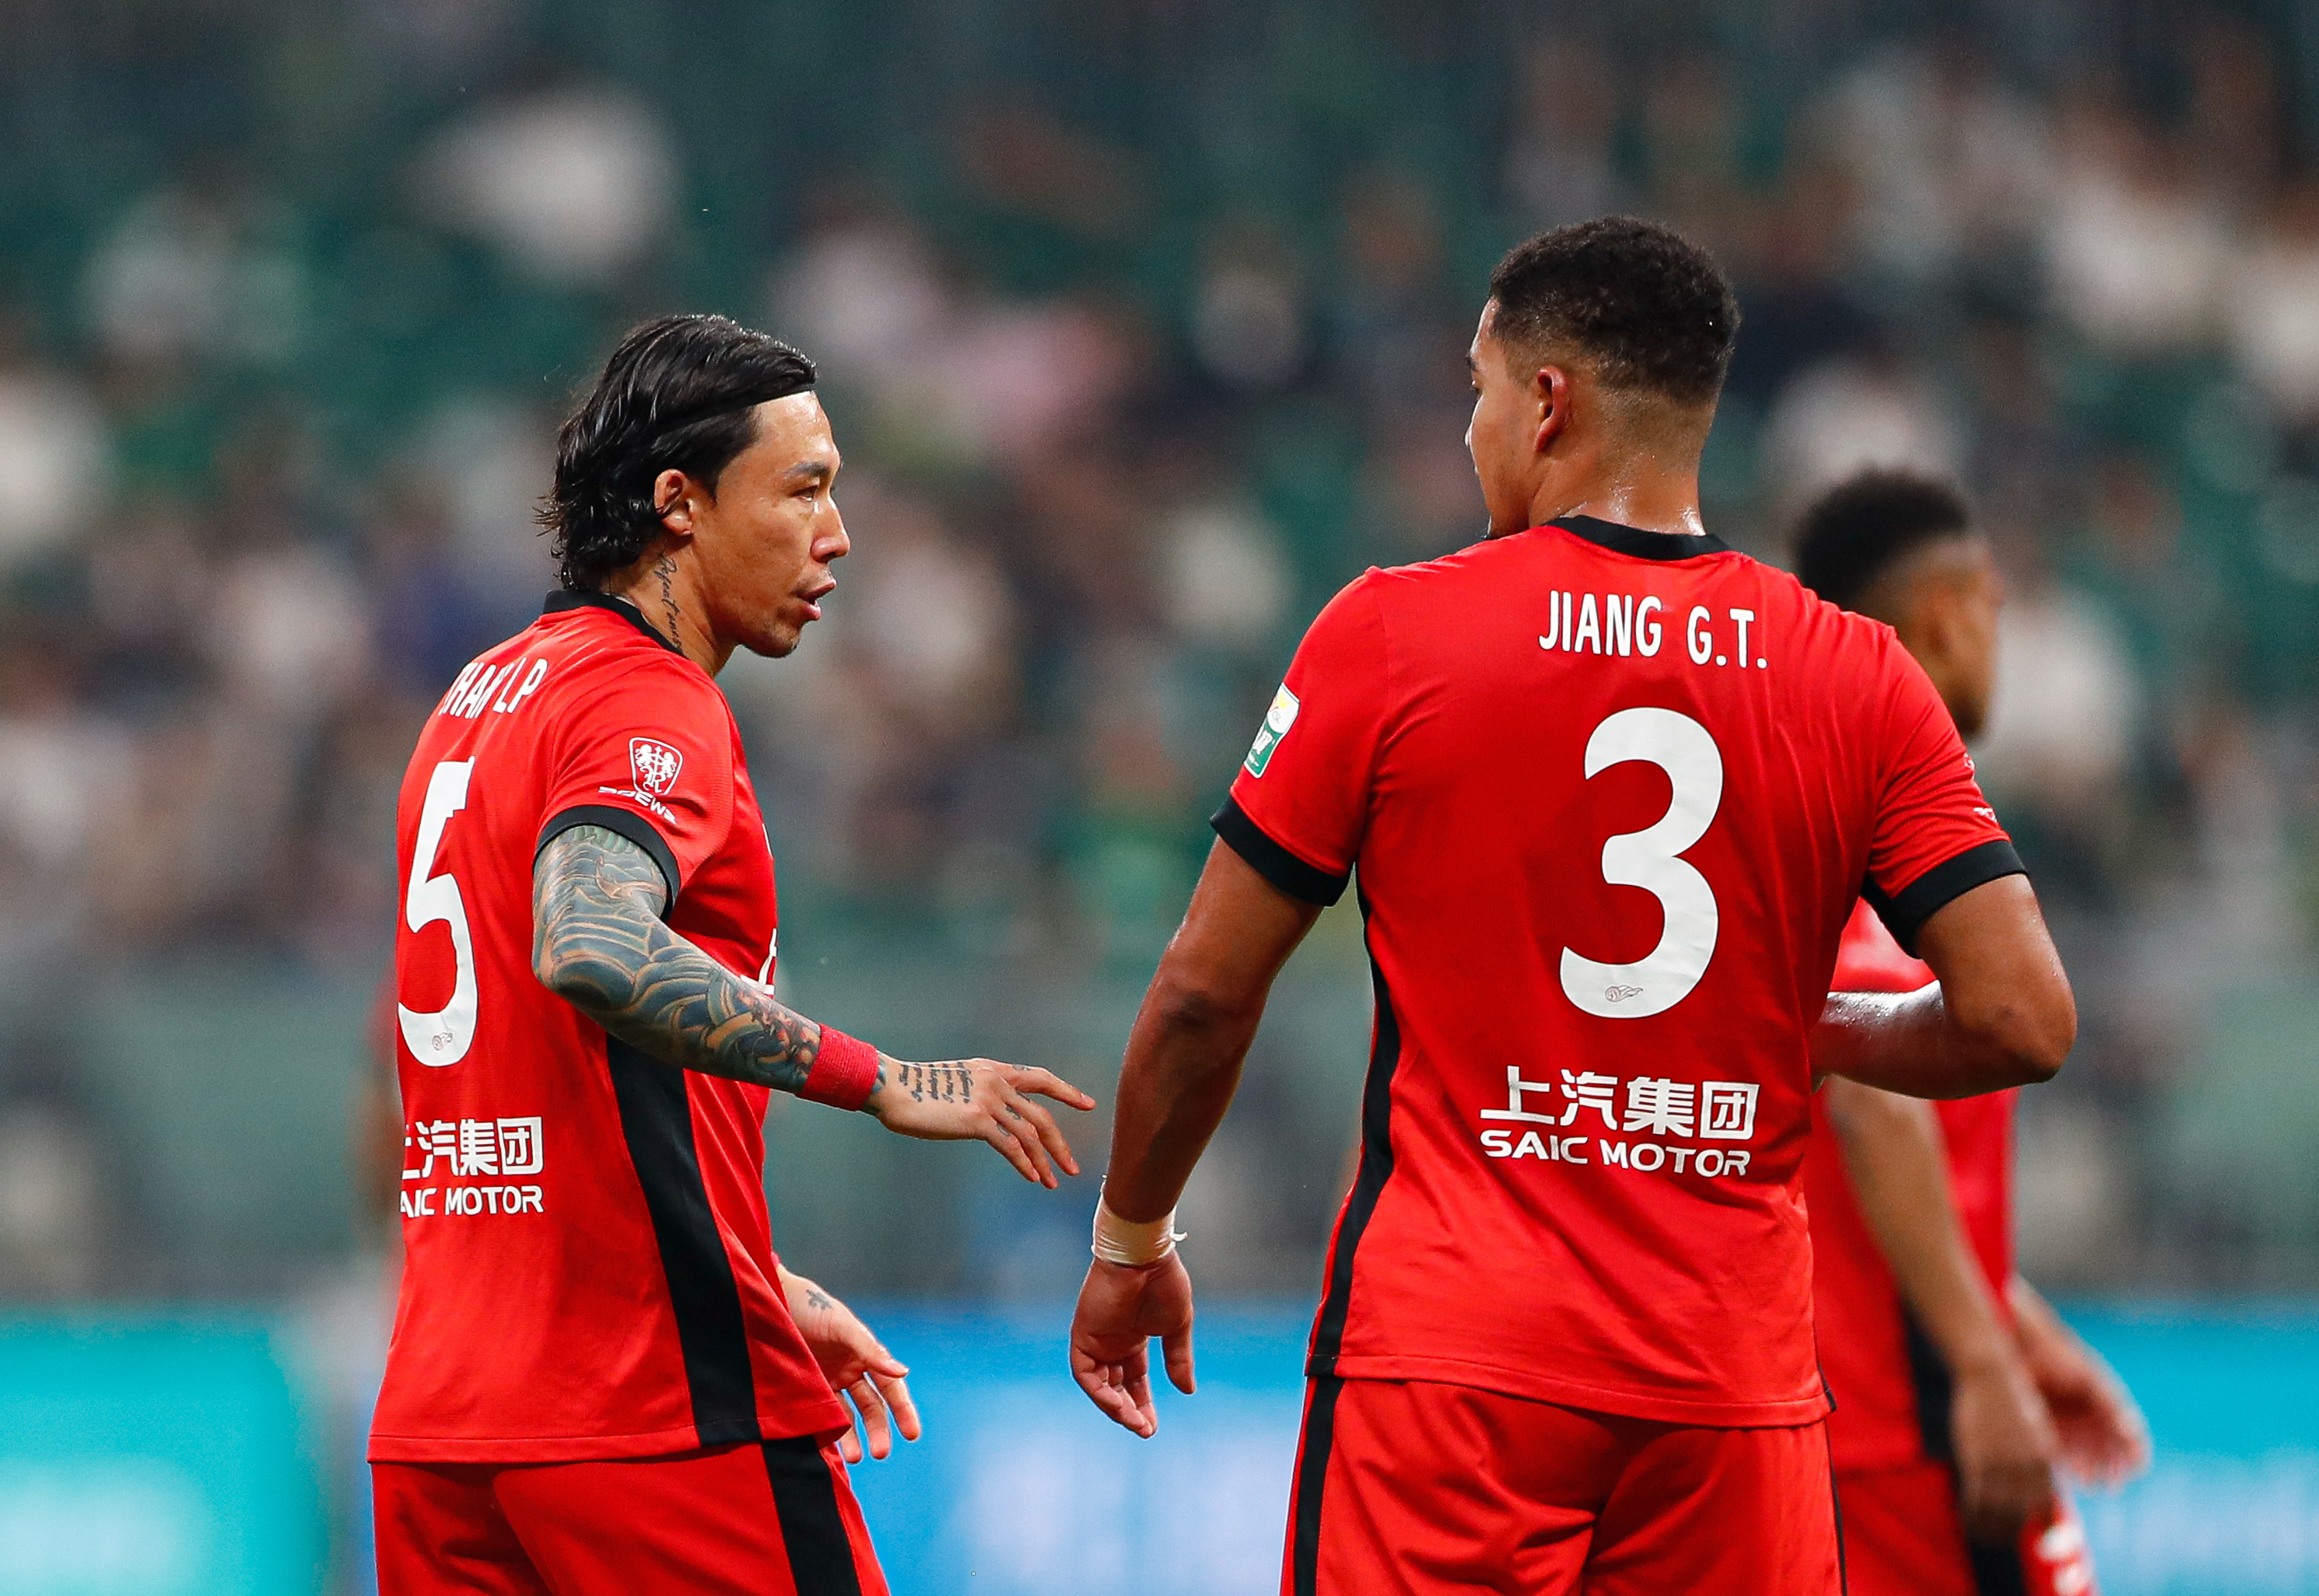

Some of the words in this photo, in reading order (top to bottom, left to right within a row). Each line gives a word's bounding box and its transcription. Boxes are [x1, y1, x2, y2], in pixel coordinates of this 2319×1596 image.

[1539, 590, 1662, 657] JIANG
[1687, 605, 1767, 669] G.T.
[1559, 706, 1723, 1019] 3
[398, 755, 478, 1067] 5
[1480, 1065, 1760, 1140] 上汽集团
[1480, 1129, 1589, 1164] SAIC
[1599, 1139, 1751, 1178] MOTOR
[445, 1185, 544, 1216] MOTOR
